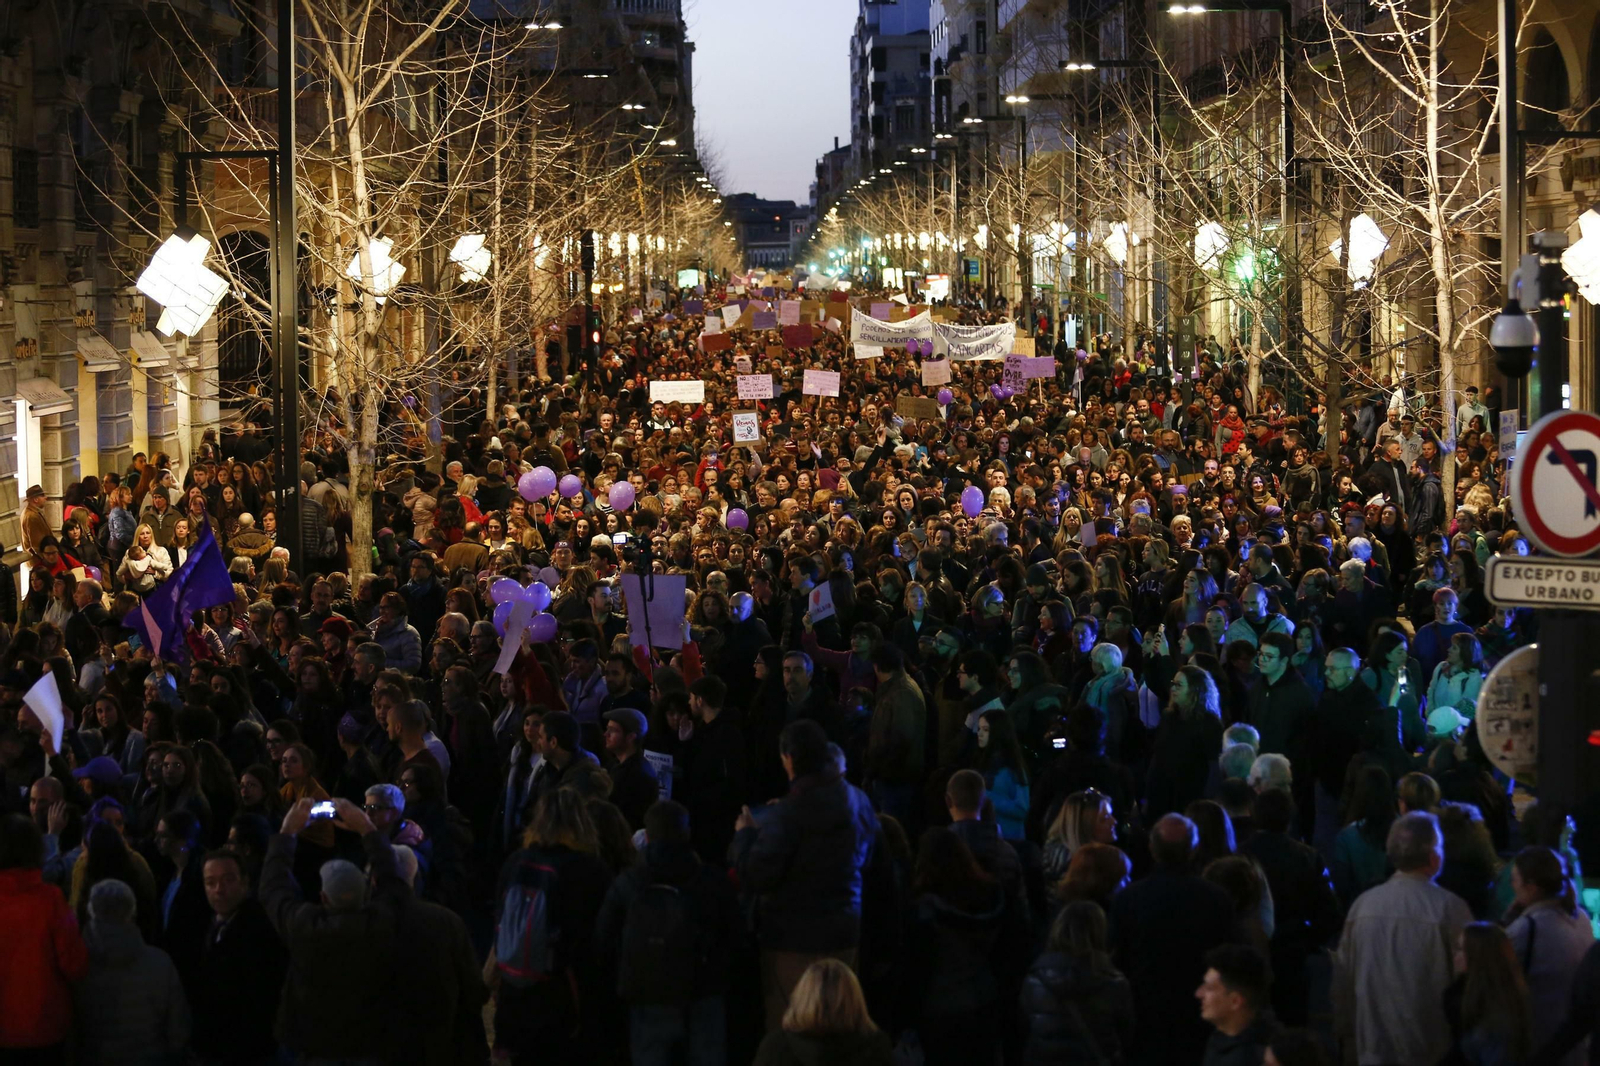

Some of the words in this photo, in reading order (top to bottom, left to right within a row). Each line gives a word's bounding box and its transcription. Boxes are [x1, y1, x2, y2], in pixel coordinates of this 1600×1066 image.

[861, 323, 891, 335] PODEMOS
[947, 340, 1003, 357] PANCARTAS
[1502, 566, 1576, 582] EXCEPTO
[1137, 579, 1165, 596] YALE
[1525, 585, 1594, 600] URBANO
[644, 753, 670, 764] NOSOTRAS
